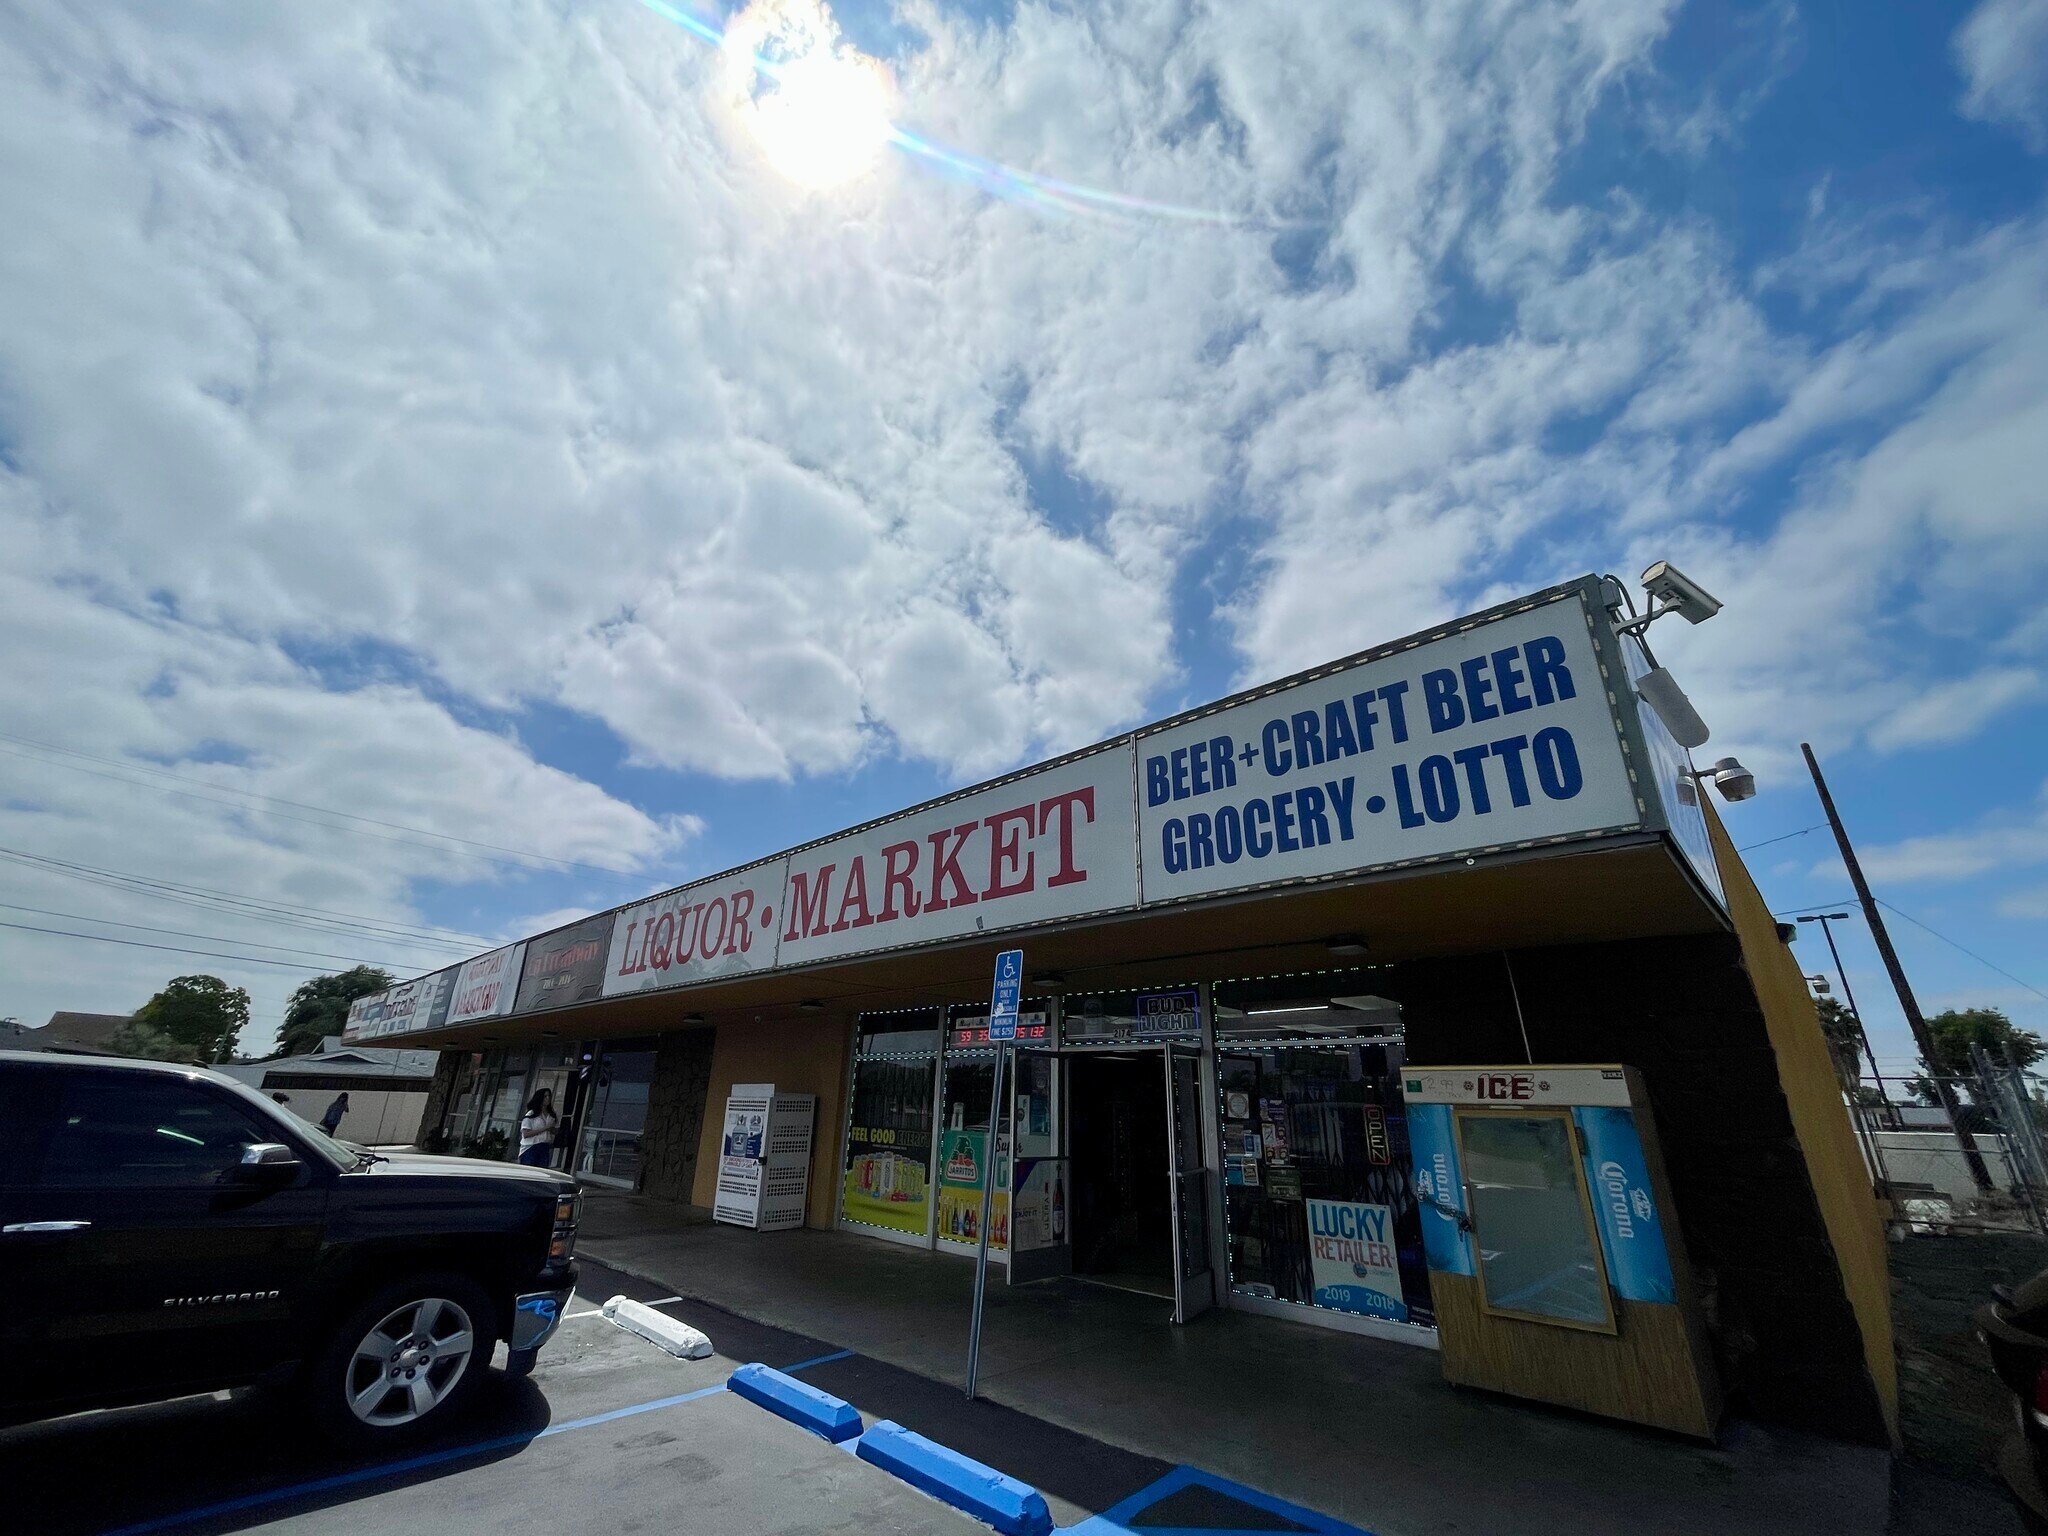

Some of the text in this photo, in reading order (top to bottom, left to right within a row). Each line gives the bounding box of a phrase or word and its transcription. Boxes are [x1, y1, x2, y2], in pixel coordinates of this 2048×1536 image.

[1422, 635, 1577, 735] BEER
[1161, 726, 1584, 875] GROCERY LOTTO
[618, 785, 1096, 977] LIQUOR MARKET
[997, 979, 1018, 988] PARKING
[1000, 989, 1013, 998] ONLY
[1147, 997, 1187, 1015] BUD
[961, 1031, 972, 1042] 59
[1031, 1026, 1046, 1038] 132
[1114, 1029, 1132, 1038] 2174
[1140, 1013, 1195, 1031] LIGHT
[1478, 1073, 1535, 1100] ICE
[852, 1126, 868, 1142] FEEL
[870, 1127, 896, 1145] GOOD
[1367, 1109, 1386, 1163] OPEN
[1600, 1161, 1635, 1239] Corona
[1310, 1203, 1386, 1243] LUCKY
[1313, 1236, 1393, 1269] RETAILER
[163, 1290, 280, 1307] SILVERADO
[1324, 1286, 1396, 1311] 2019 2018
